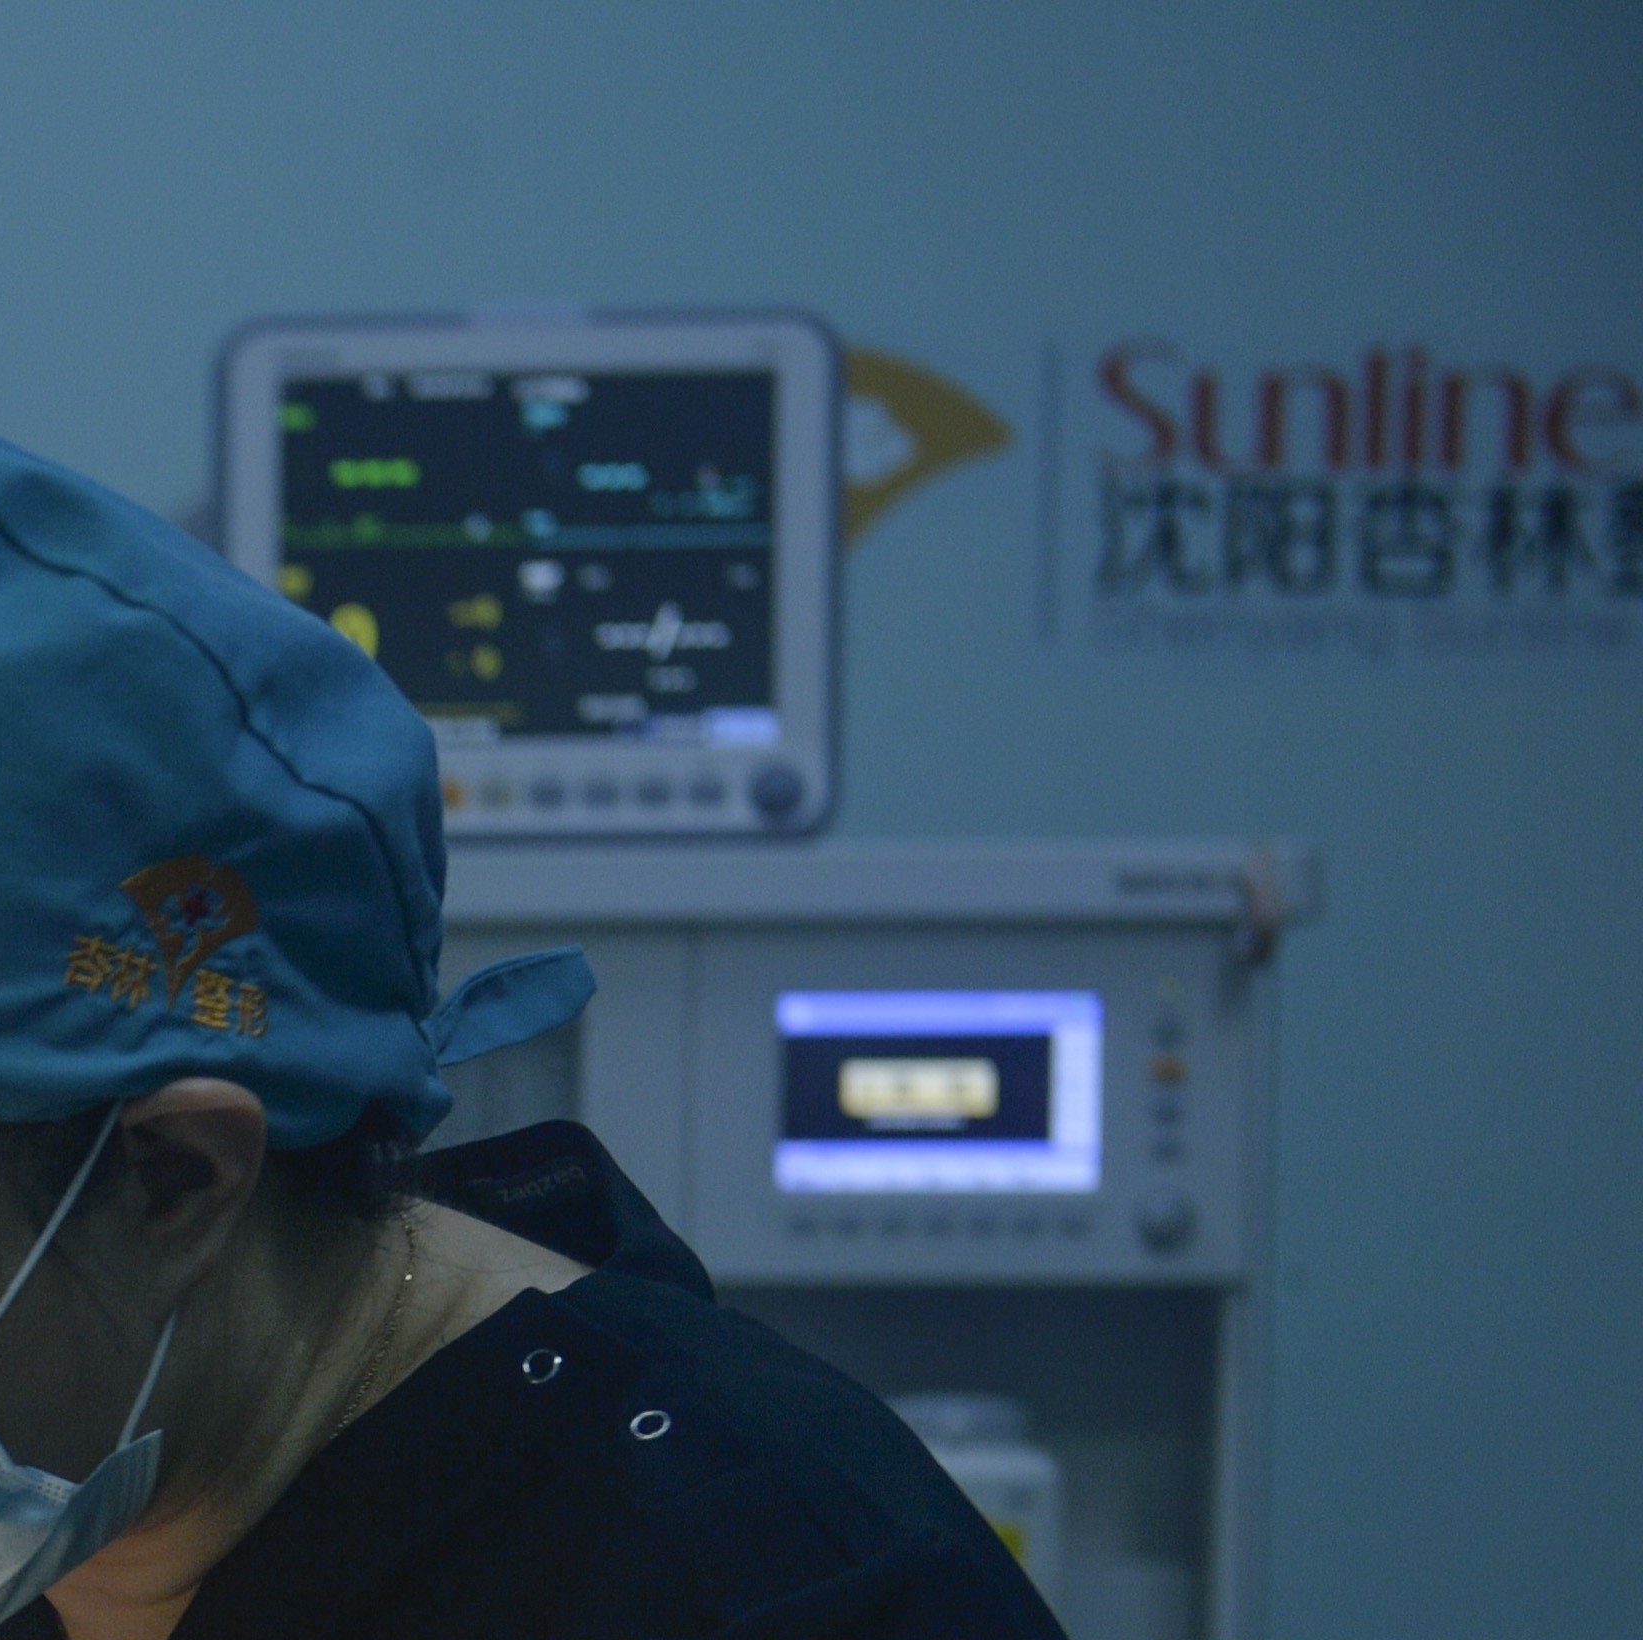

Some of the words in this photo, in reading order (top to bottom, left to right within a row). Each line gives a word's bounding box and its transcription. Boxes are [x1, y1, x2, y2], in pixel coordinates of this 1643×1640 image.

[1095, 335, 1643, 482] Sunline
[1097, 476, 1643, 597] 沈阳杏林
[67, 934, 158, 1009] 杏林
